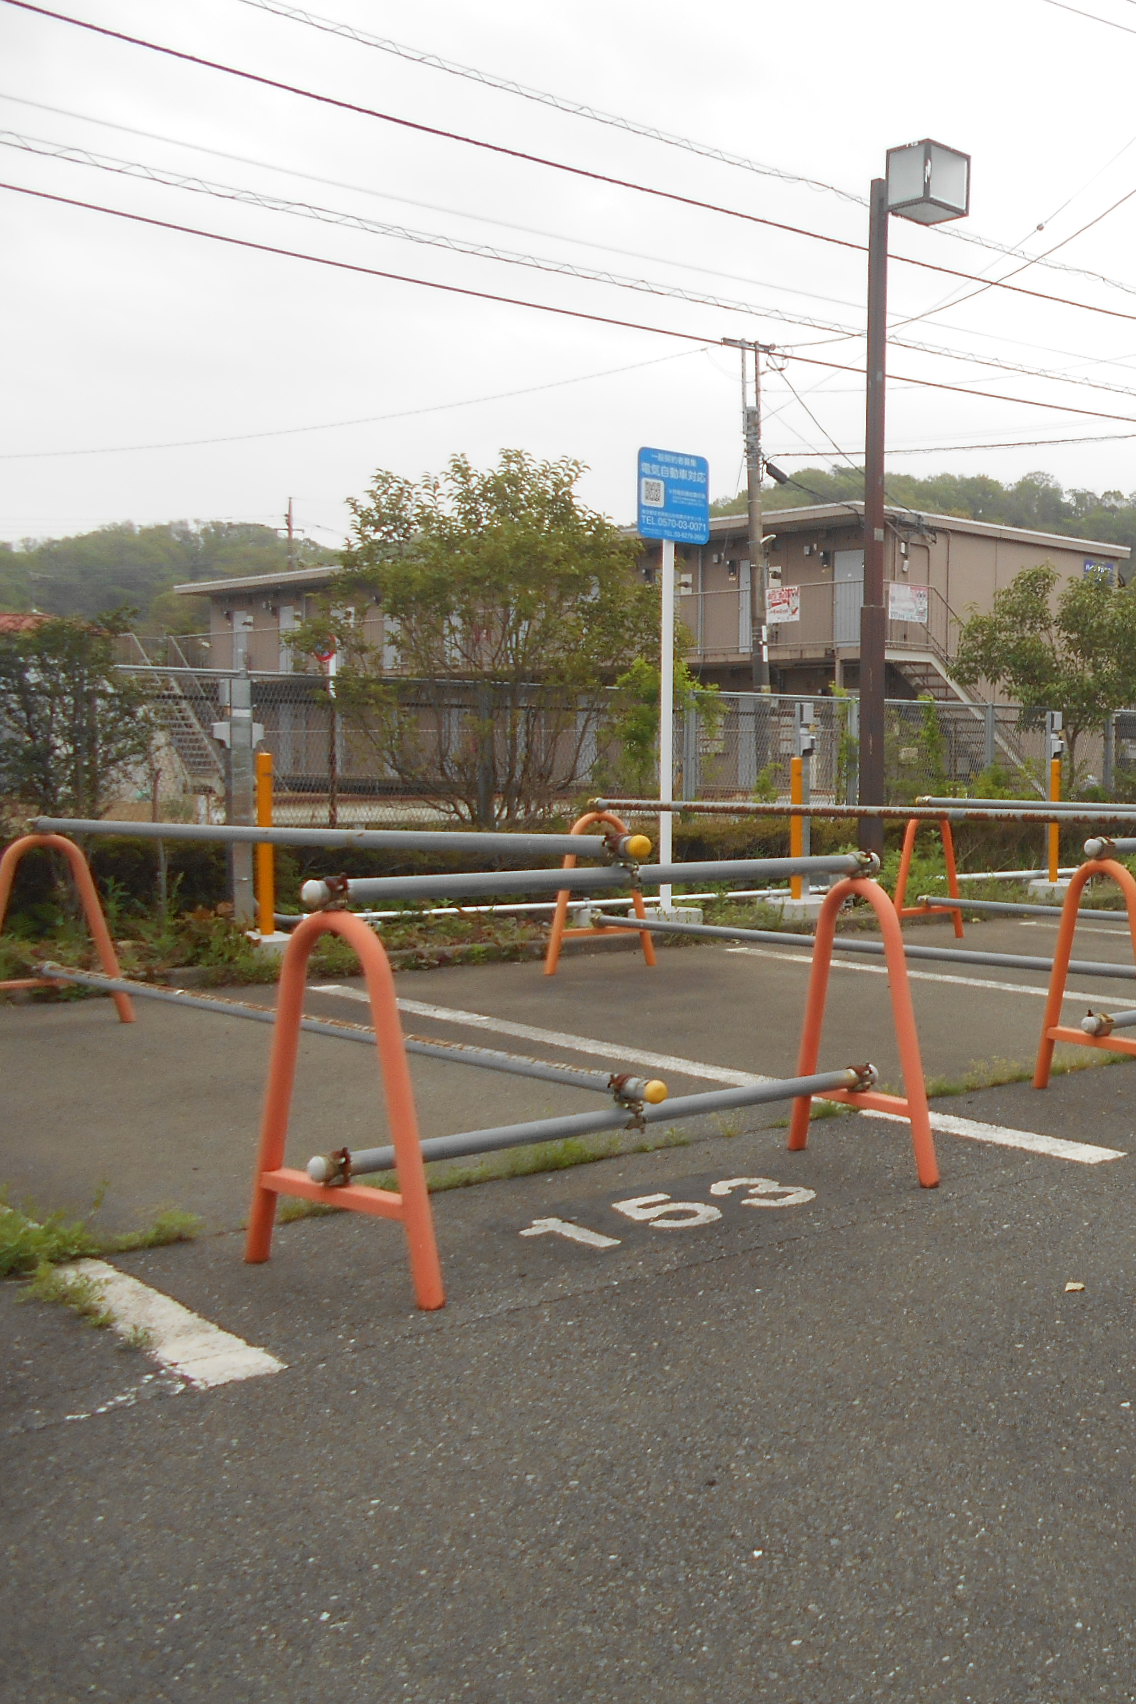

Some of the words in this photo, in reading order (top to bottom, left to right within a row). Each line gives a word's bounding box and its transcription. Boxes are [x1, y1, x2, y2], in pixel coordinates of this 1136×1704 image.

[641, 463, 706, 483] 電気自動車対応
[519, 1177, 816, 1247] 153
